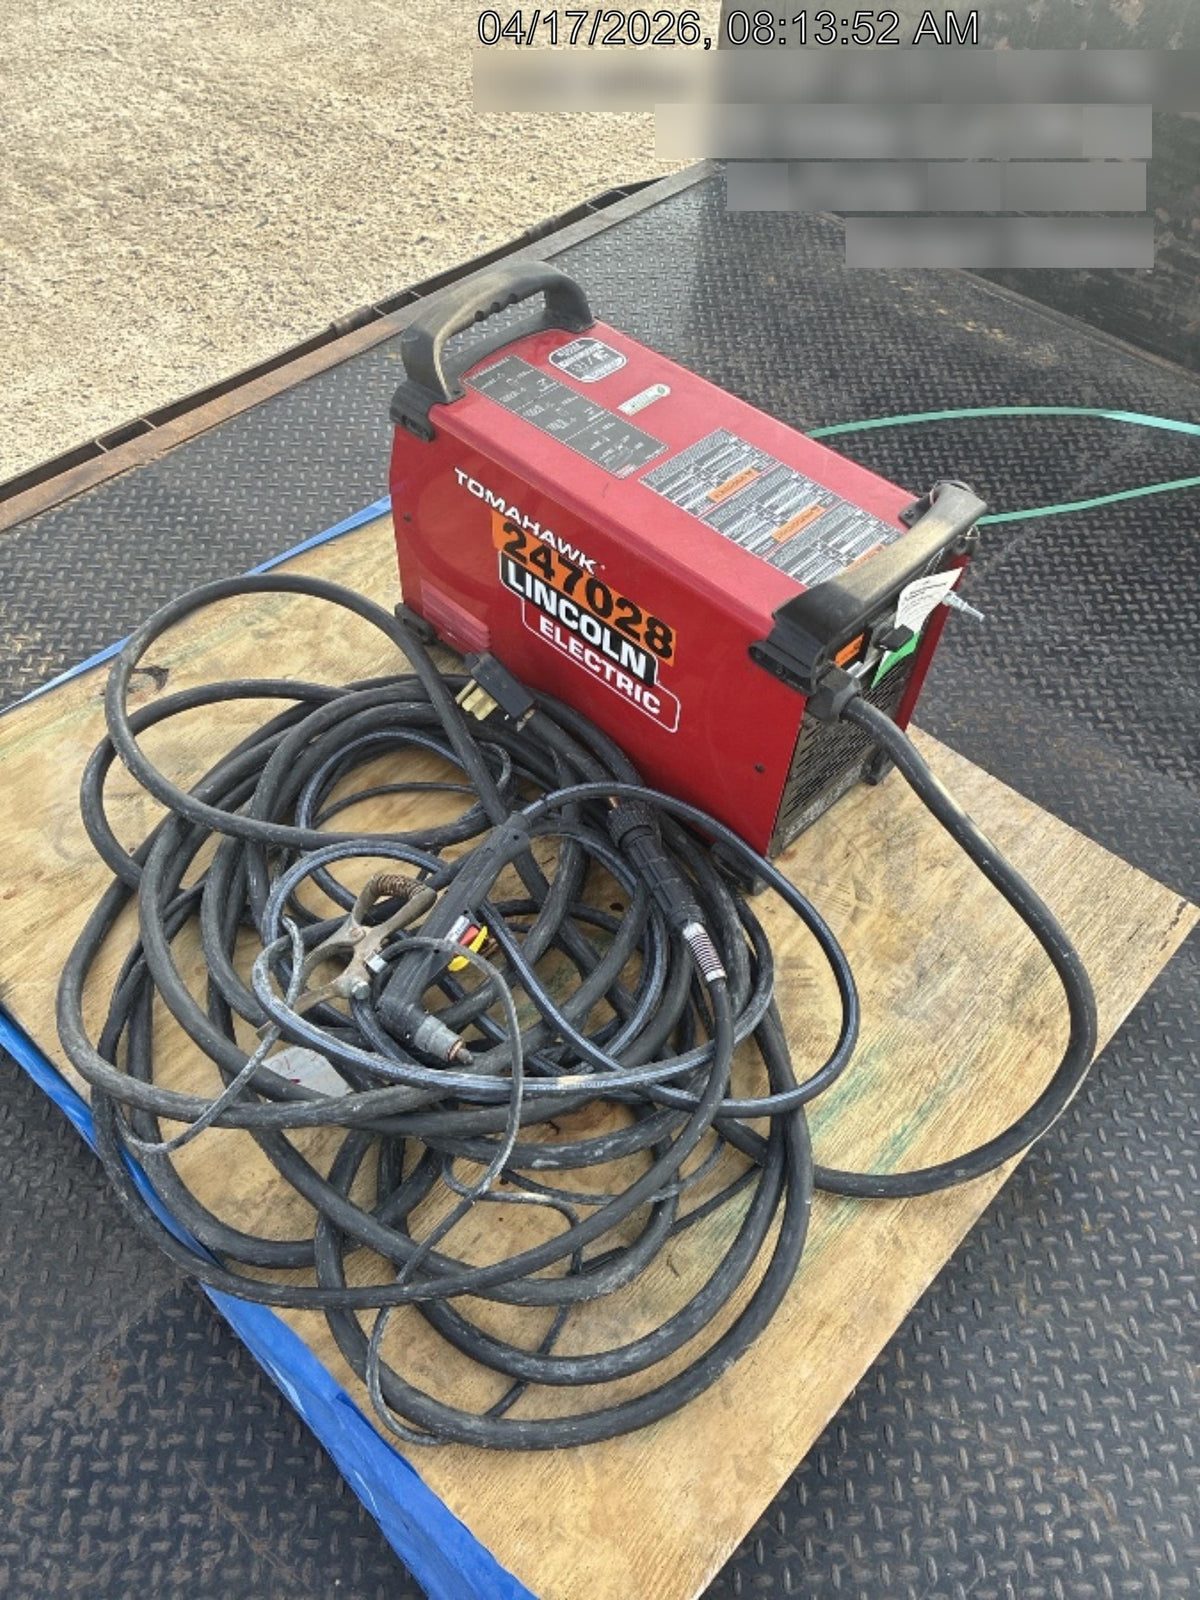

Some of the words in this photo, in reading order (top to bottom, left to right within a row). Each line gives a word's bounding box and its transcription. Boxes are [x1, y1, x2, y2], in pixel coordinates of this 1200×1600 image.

[454, 467, 598, 575] TOMAHAWK
[502, 521, 674, 660] 247028
[507, 560, 647, 681] LINCOLN
[539, 614, 661, 715] ELECTRIC
